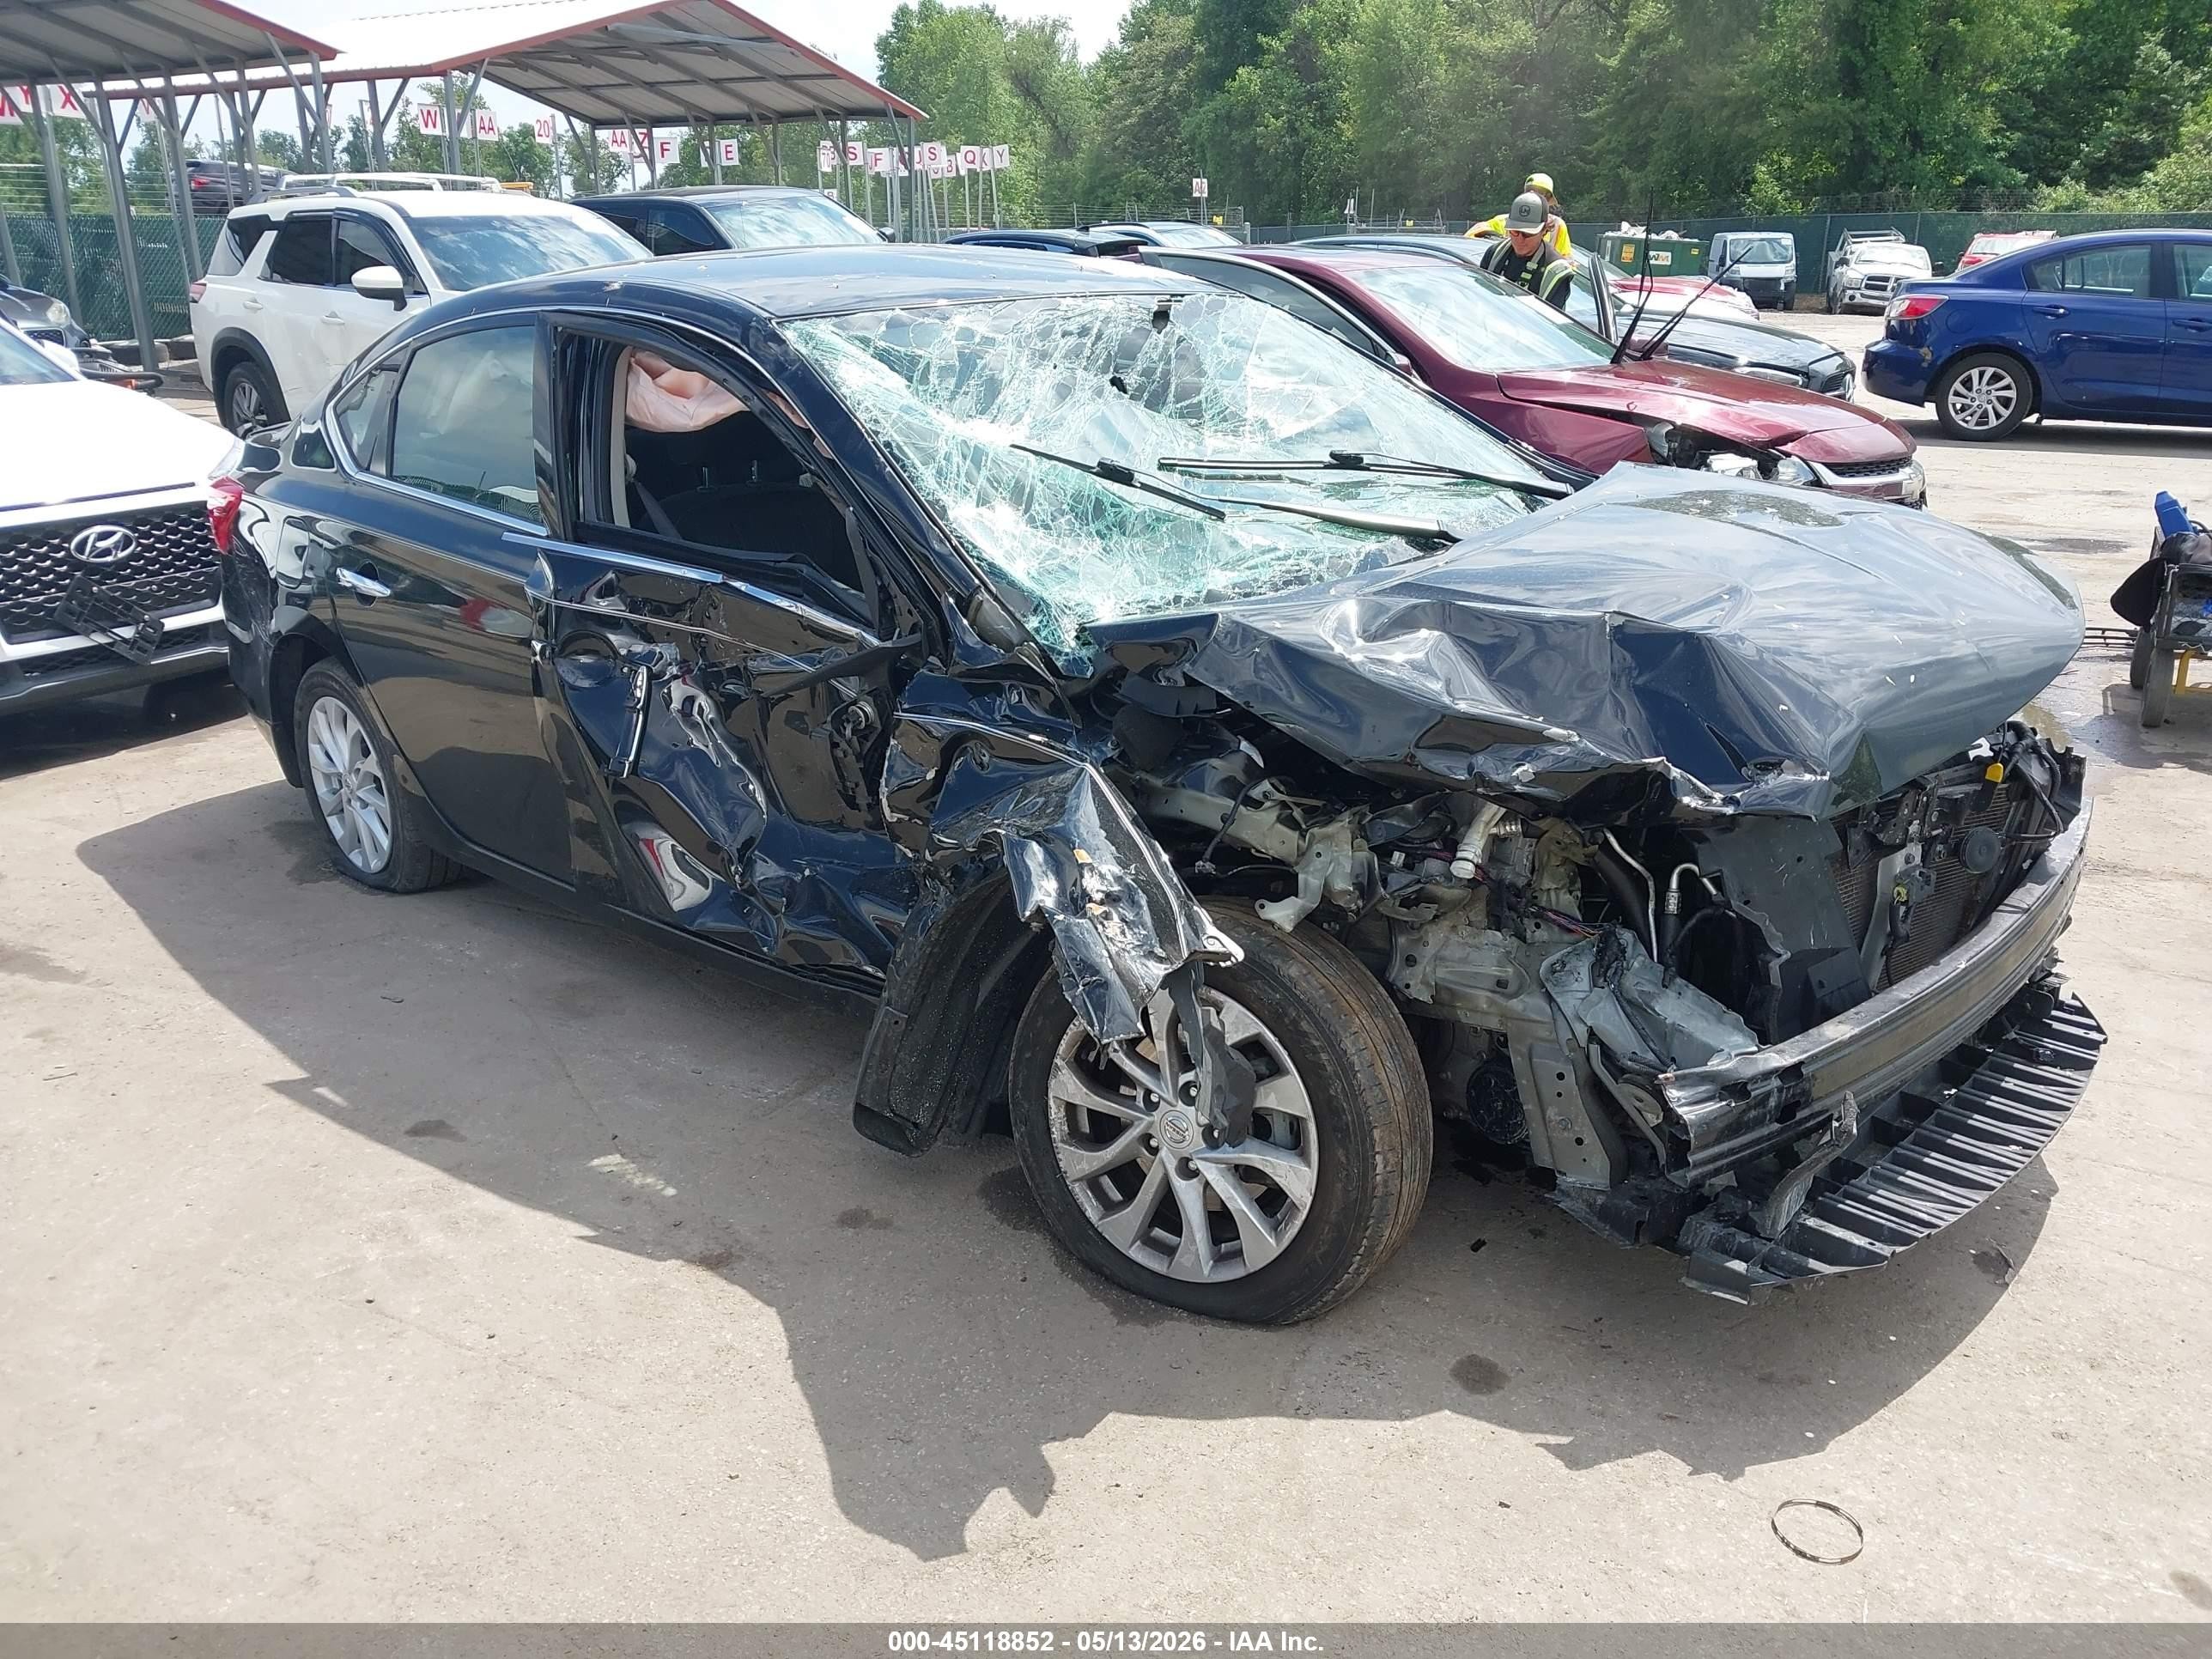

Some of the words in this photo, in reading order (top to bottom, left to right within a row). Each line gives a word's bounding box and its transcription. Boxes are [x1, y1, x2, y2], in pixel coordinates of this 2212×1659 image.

[58, 84, 78, 111] X
[420, 108, 438, 129] W
[478, 115, 495, 136] AA
[536, 118, 550, 138] 20
[611, 130, 628, 148] AA
[659, 141, 672, 159] F
[725, 143, 733, 161] E
[847, 146, 858, 161] S
[927, 146, 938, 161] S
[963, 149, 976, 166] Q
[996, 149, 1005, 163] Y
[874, 152, 884, 167] F
